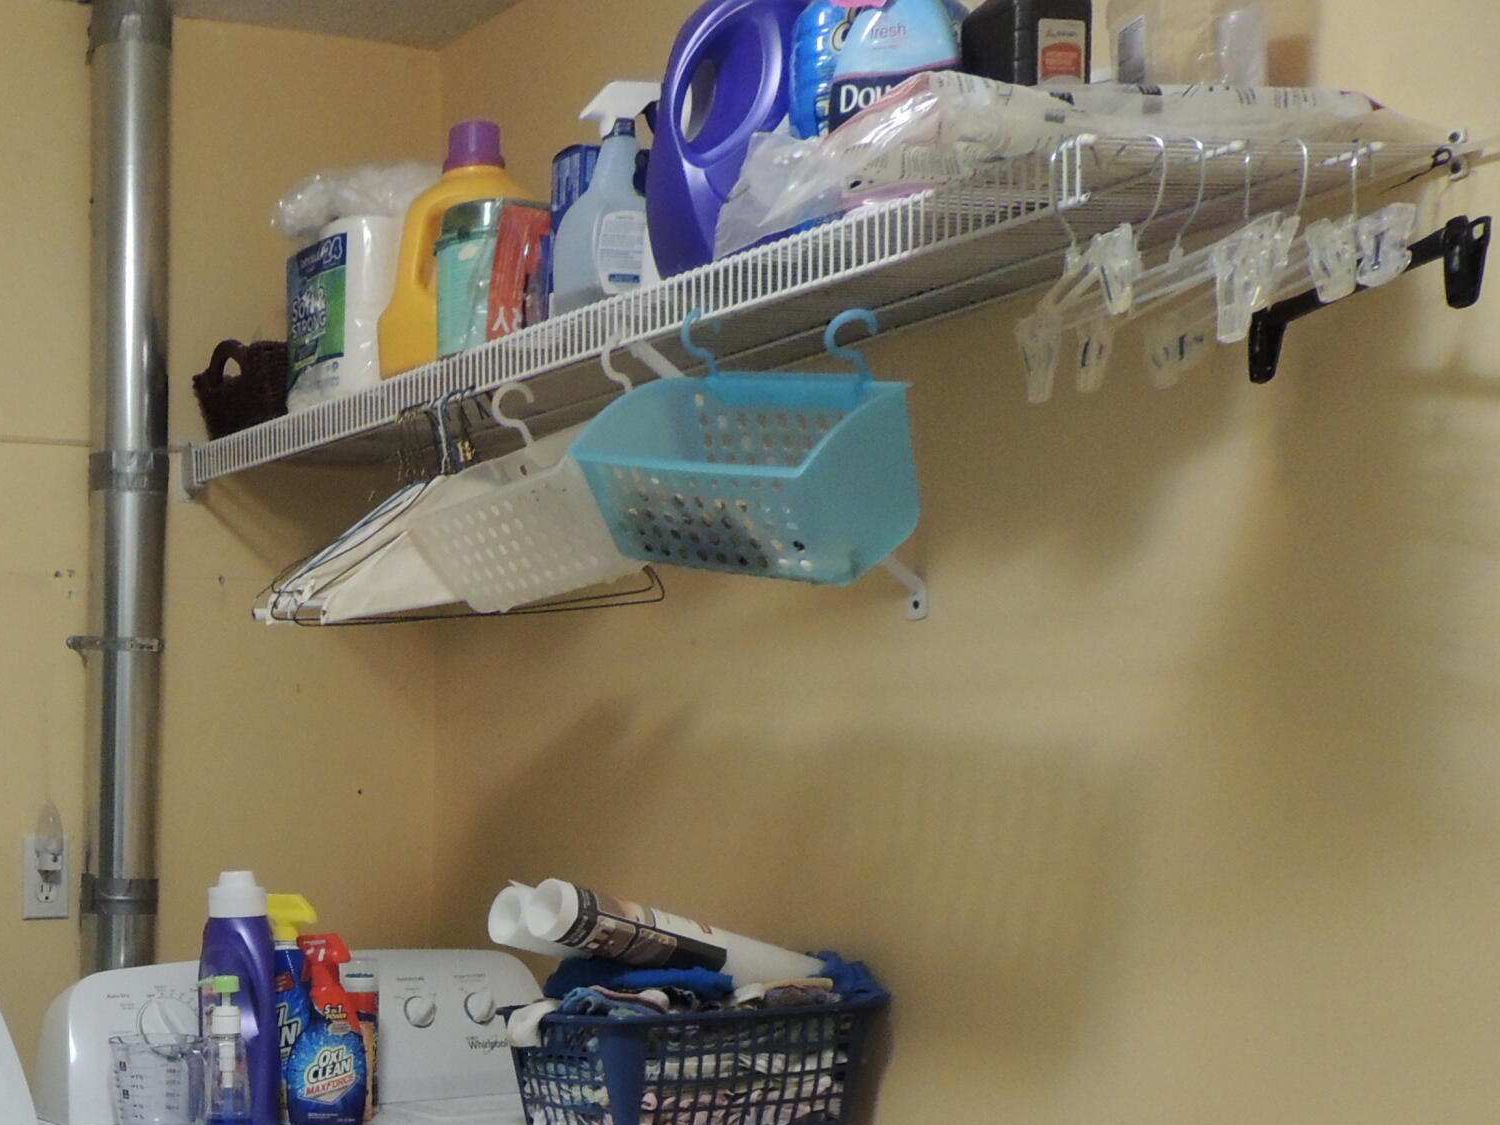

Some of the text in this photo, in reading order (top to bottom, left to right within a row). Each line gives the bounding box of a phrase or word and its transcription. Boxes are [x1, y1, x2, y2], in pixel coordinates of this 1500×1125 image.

[291, 311, 327, 340] STRONG
[318, 1049, 344, 1069] OXI
[307, 1059, 352, 1085] CLEAN
[306, 1076, 355, 1097] MAXFORCE
